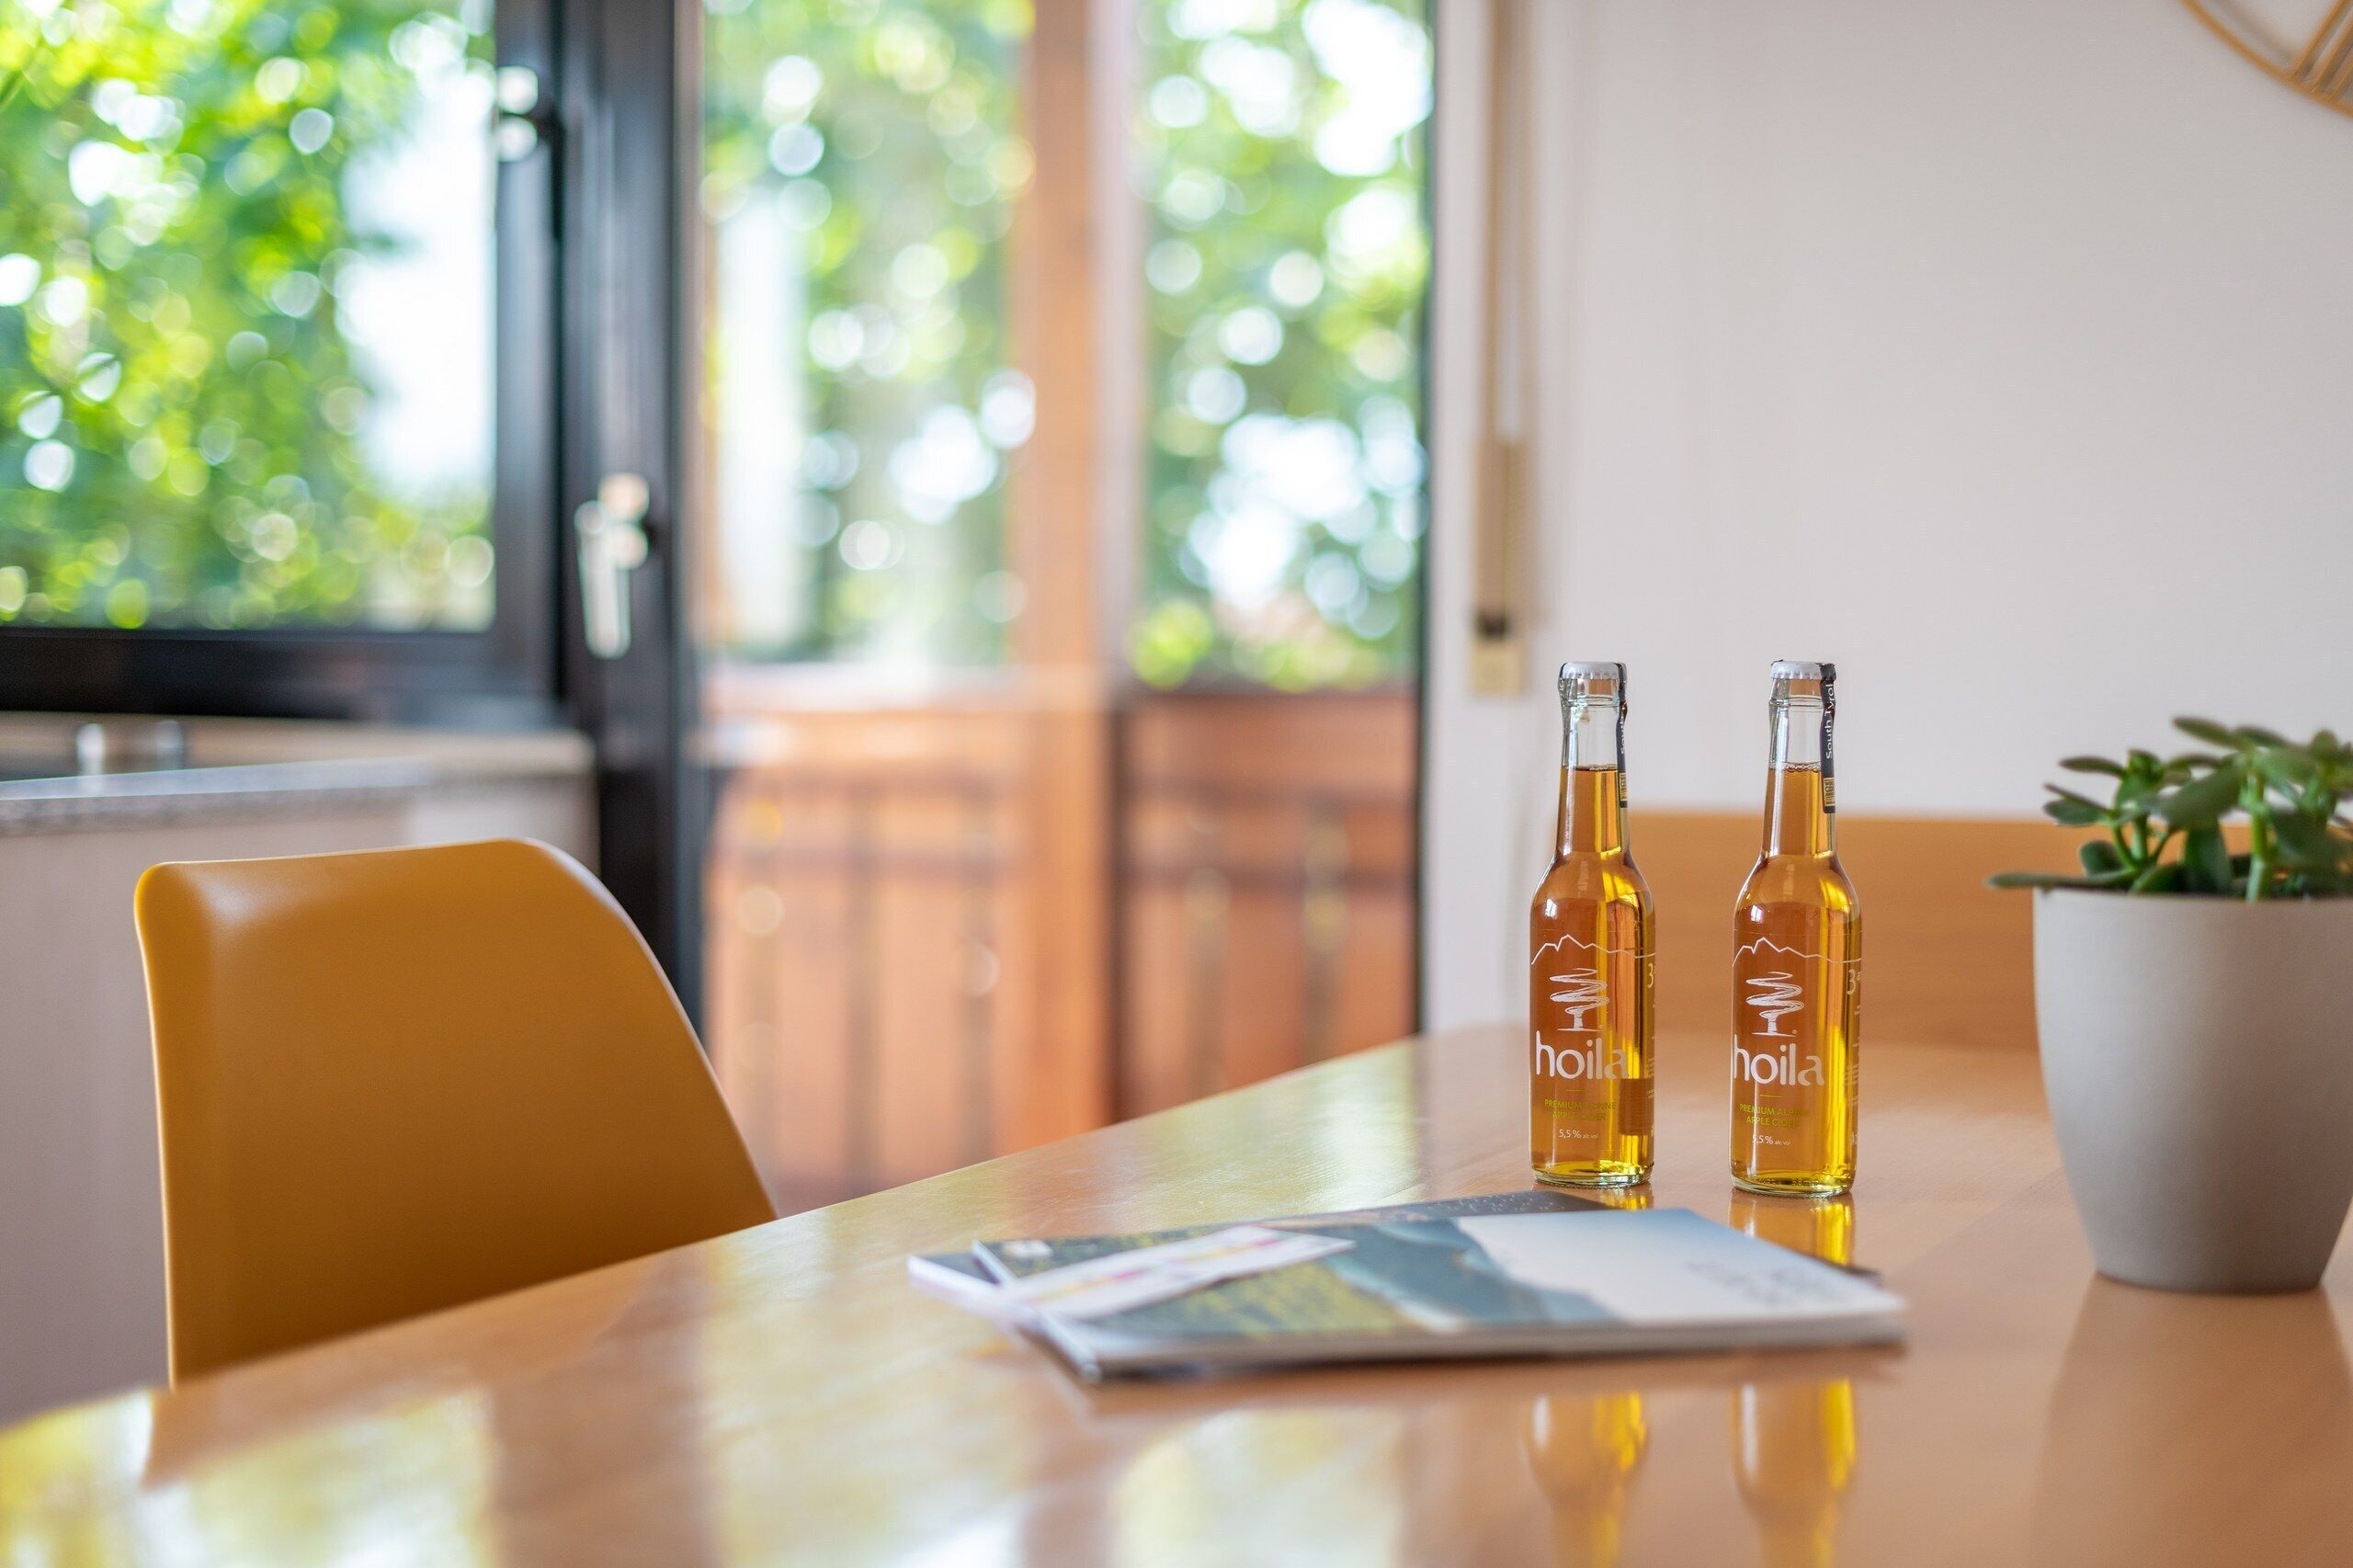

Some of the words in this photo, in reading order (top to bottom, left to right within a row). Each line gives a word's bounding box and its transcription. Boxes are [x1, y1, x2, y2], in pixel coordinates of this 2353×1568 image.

[1824, 683, 1835, 715] Tyrol
[1824, 720, 1833, 759] South
[1536, 1030, 1628, 1079] hoila
[1733, 1034, 1824, 1086] hoila
[1544, 1099, 1582, 1110] PREMIUM
[1739, 1104, 1775, 1116] PREMIUM
[1745, 1116, 1770, 1126] APPLE
